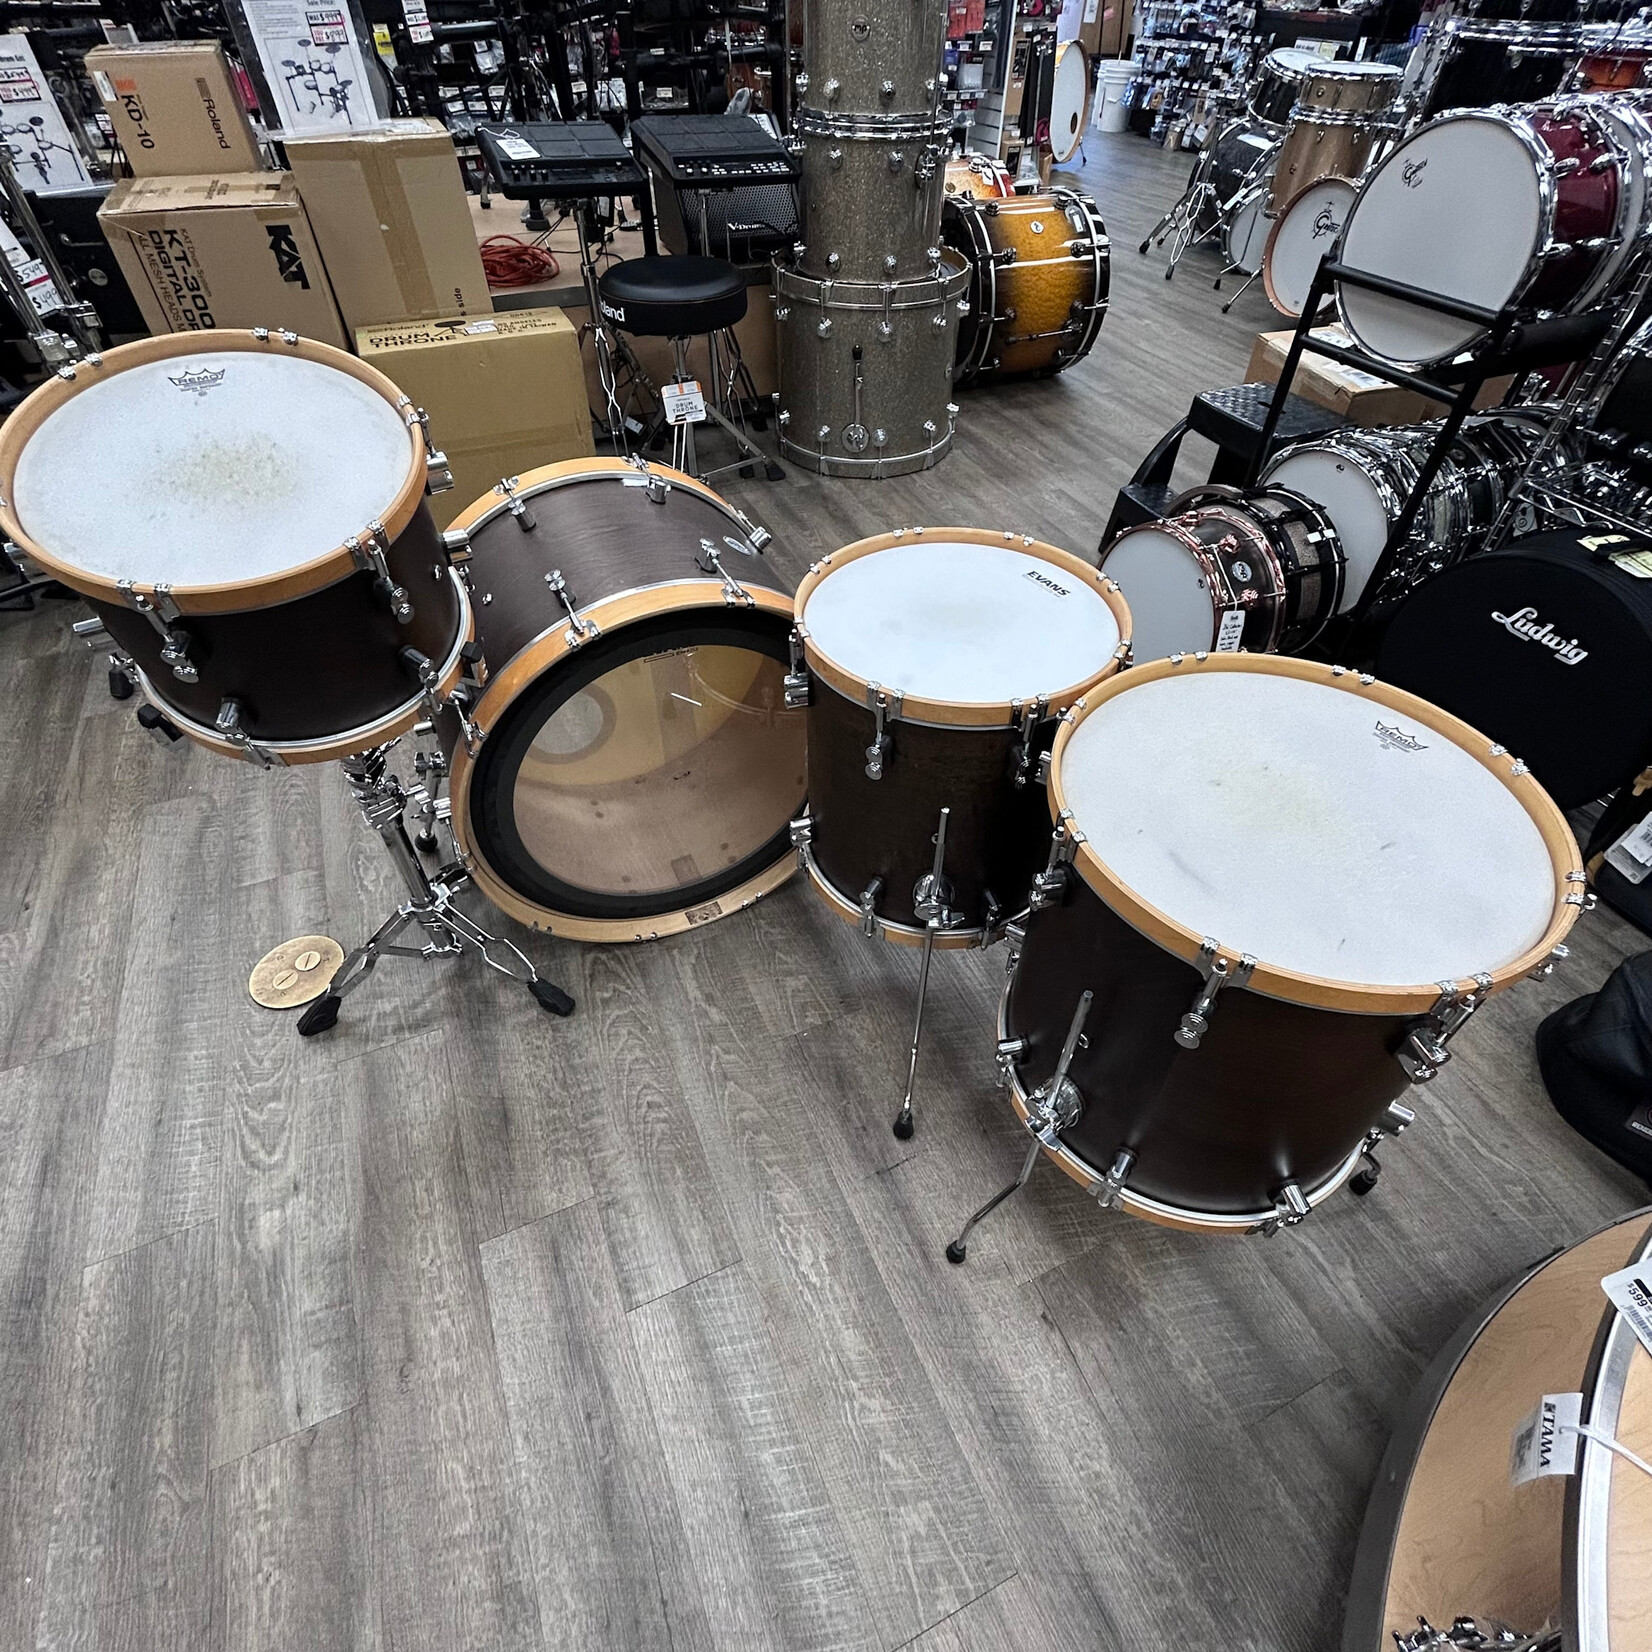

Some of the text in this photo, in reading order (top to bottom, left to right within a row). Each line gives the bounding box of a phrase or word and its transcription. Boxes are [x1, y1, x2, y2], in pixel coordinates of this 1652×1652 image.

[120, 94, 155, 149] KD-10
[203, 99, 231, 149] Roland
[180, 228, 193, 244] KAT
[265, 224, 311, 290] KAT
[147, 253, 168, 287] MESH
[160, 286, 181, 327] HEADS
[148, 230, 184, 306] DIGITAL
[163, 229, 216, 329] KT-300
[454, 287, 465, 308] side
[369, 332, 430, 344] DRUM
[371, 335, 458, 348] THRONE
[672, 405, 698, 413] THRONE
[1027, 570, 1071, 596] EVANS
[1491, 607, 1589, 665] Ludwig
[1627, 1282, 1648, 1308] $599
[1540, 1414, 1556, 1467] TAMA
